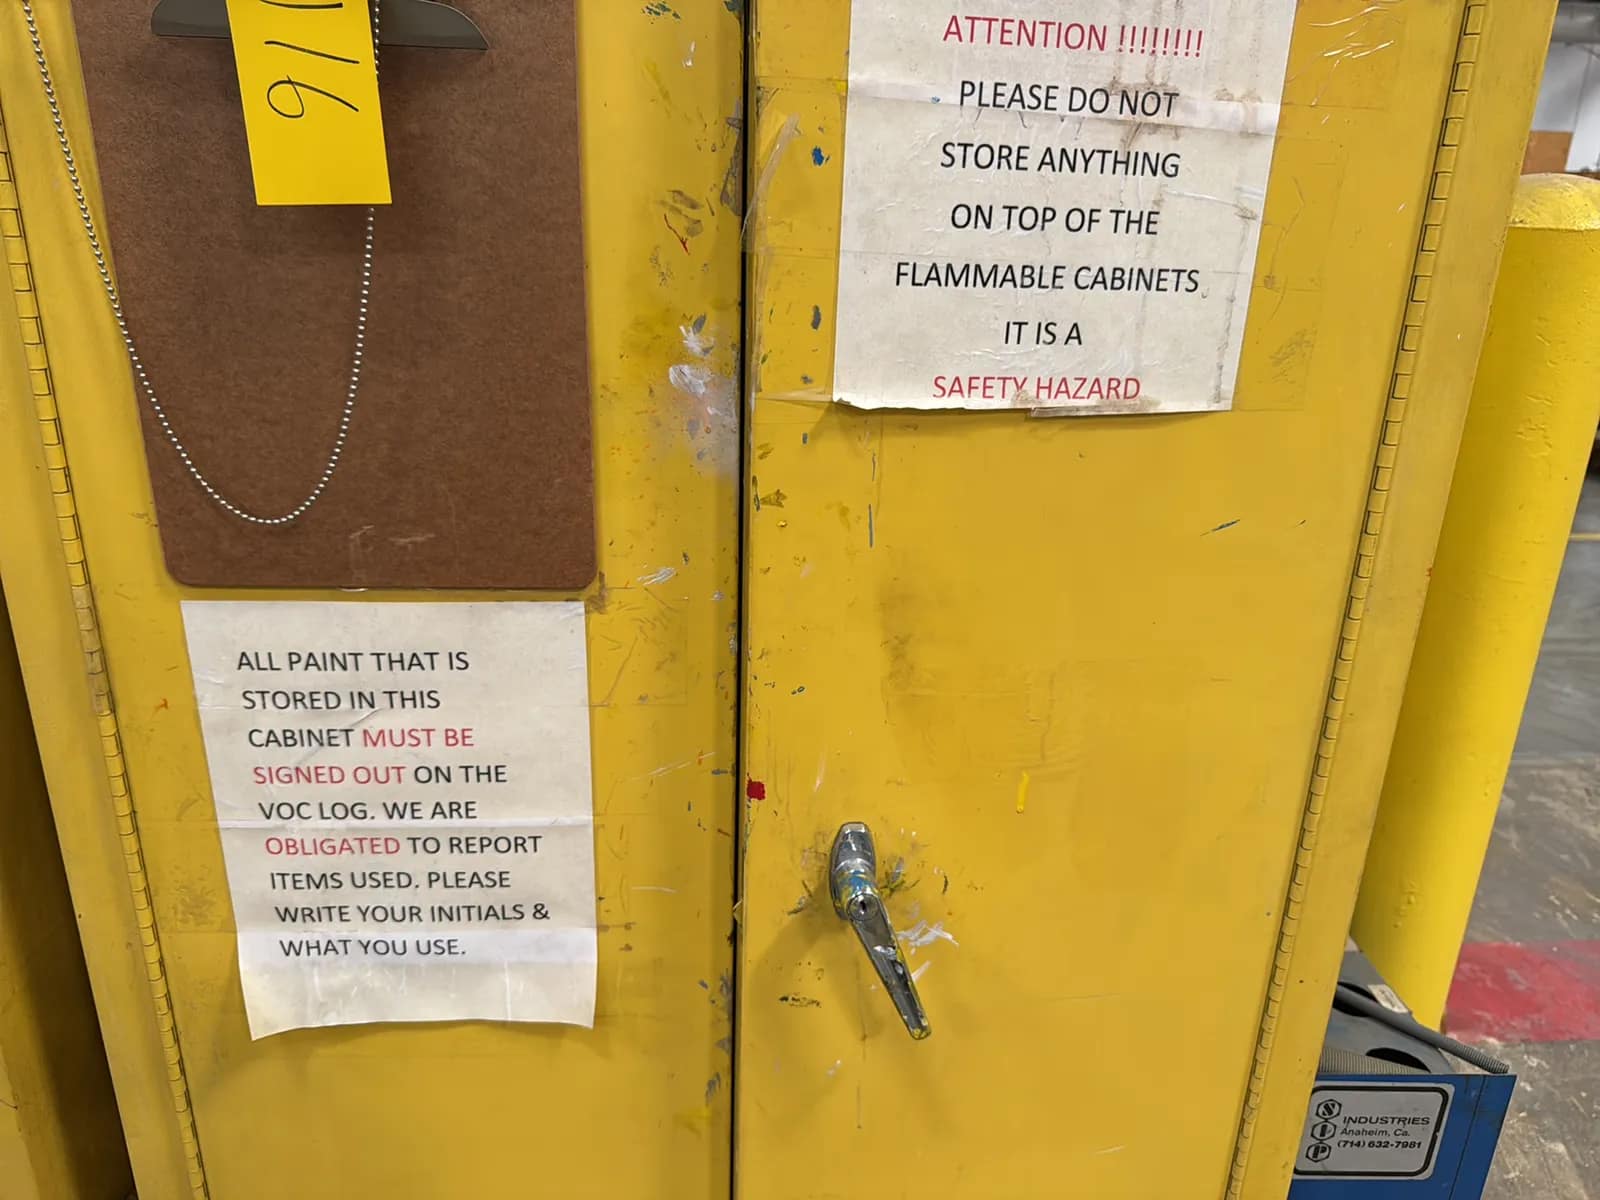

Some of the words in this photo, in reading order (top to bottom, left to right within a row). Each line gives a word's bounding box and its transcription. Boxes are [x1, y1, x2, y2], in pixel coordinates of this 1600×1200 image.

[942, 14, 1108, 52] ATTENTION
[1117, 23, 1204, 58] !!!!!!!!
[959, 79, 1060, 112] PLEASE
[1067, 86, 1110, 114] DO
[1118, 90, 1181, 118] NOT
[940, 141, 1031, 172] STORE
[1036, 146, 1182, 179] ANYTHING
[950, 203, 994, 231] ON
[1001, 204, 1058, 233] TOP
[1064, 207, 1102, 234] OF
[1108, 208, 1162, 236] THE
[895, 261, 1067, 291] FLAMMABLE
[1004, 320, 1029, 346] IT
[1035, 320, 1058, 347] IS
[1063, 321, 1083, 347] A
[932, 374, 1029, 400] SAFETY
[1035, 375, 1142, 401] HAZARD
[236, 651, 282, 672] ALL
[287, 651, 365, 672] PAINT
[369, 651, 441, 672] THAT
[447, 651, 470, 671] IS
[241, 689, 342, 710] STORED
[349, 689, 377, 710] IN
[381, 689, 442, 710] THIS
[247, 727, 356, 748] CABINET
[362, 727, 437, 748] MUST
[444, 727, 475, 747] BE
[253, 765, 346, 785] SIGNED
[352, 764, 407, 785] OUT
[413, 764, 452, 785] ON
[457, 764, 508, 784] THE
[257, 801, 313, 821] VOC
[318, 801, 376, 821] LOG.
[381, 801, 424, 820] WE
[430, 800, 478, 820] ARE
[264, 836, 401, 856] OBLIGATED
[405, 836, 442, 856] TO
[448, 835, 543, 855] REPORT
[269, 871, 344, 890] ITEMS
[349, 871, 420, 890] USED.
[427, 870, 512, 889] PLEASE
[273, 905, 352, 924] WRITE
[356, 904, 424, 923] YOUR
[430, 903, 526, 923] INITIALS
[532, 902, 551, 921] &
[279, 938, 354, 957] WHAT
[357, 938, 409, 957] YOU
[415, 938, 467, 957] USE.
[1343, 1115, 1431, 1126] INDUSTRIES
[1340, 1127, 1391, 1137] Anaheim,
[1393, 1127, 1411, 1137] Ca.
[1337, 1139, 1366, 1149] (714)
[1367, 1140, 1422, 1149] 632-7981
